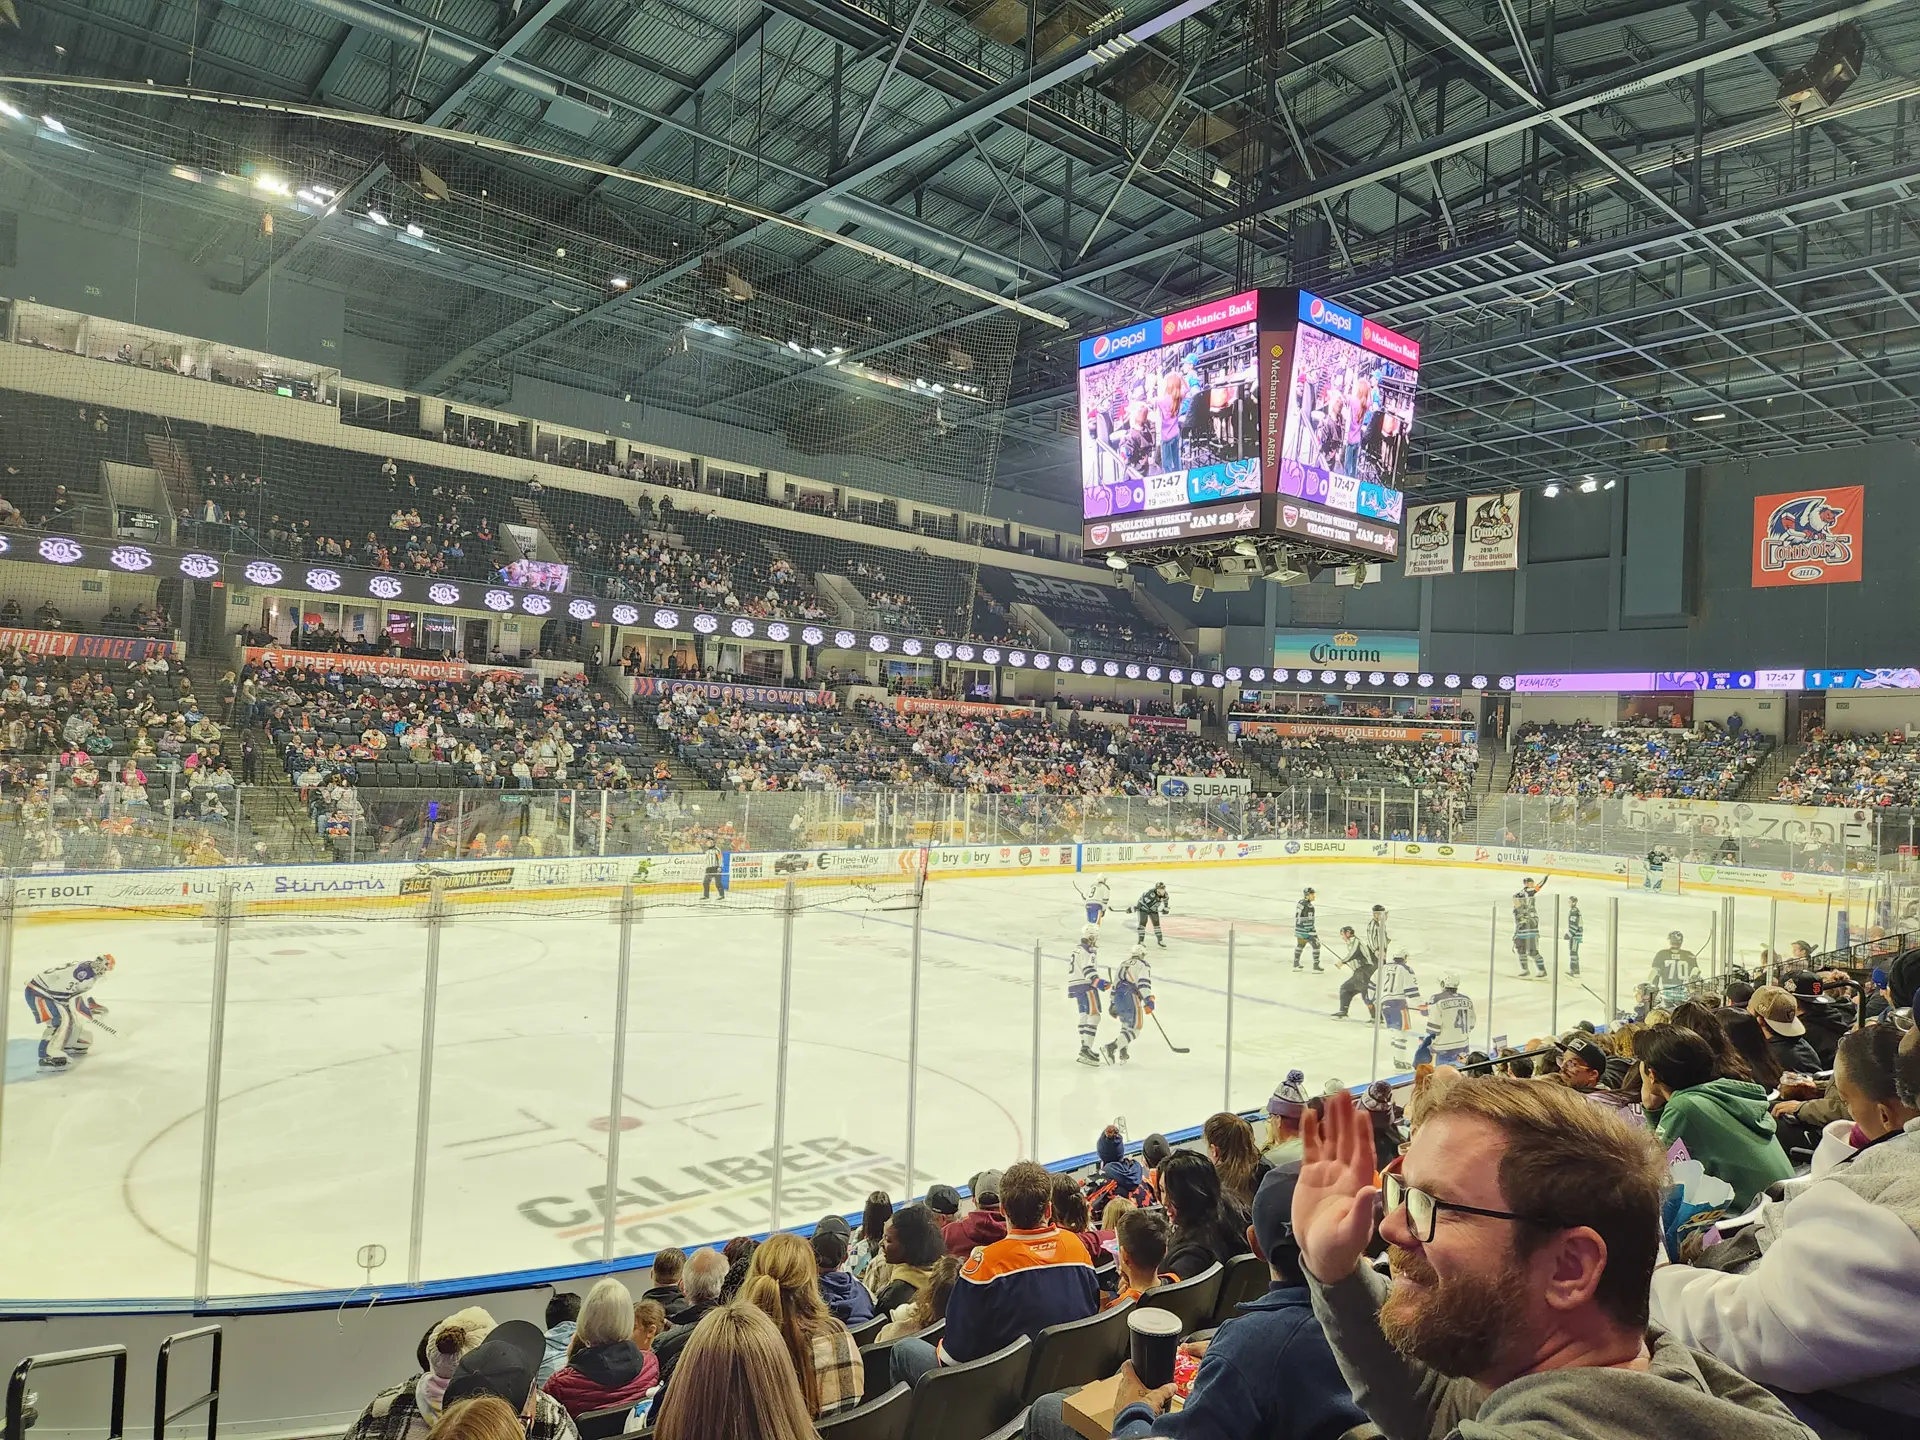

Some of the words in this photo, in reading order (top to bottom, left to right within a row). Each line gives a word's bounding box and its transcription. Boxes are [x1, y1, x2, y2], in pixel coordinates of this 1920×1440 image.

[1177, 307, 1227, 332] Mechanics
[1228, 300, 1254, 317] Bank
[1324, 310, 1352, 332] pepsi
[1111, 328, 1146, 353] pepsi
[1371, 331, 1403, 354] Mechanics
[1403, 344, 1418, 360] Bank
[1269, 359, 1281, 410] Mechanics
[1268, 412, 1279, 435] Bank
[1266, 437, 1276, 468] ARENA
[1151, 475, 1181, 490] 17:47
[1192, 477, 1200, 494] 1
[1319, 480, 1328, 496] 0
[1334, 476, 1356, 493] 17:47
[1133, 488, 1143, 503] 0
[1148, 498, 1157, 506] 19
[1176, 494, 1185, 502] 13
[1361, 490, 1366, 507] 1
[1111, 516, 1155, 533] PENDLETON
[1156, 512, 1192, 526] WHISKEY
[1190, 513, 1218, 529] JAN
[1219, 512, 1235, 526] 18
[1300, 507, 1333, 525] PENDLETON
[1332, 514, 1358, 532] WHISKEY
[1121, 529, 1159, 543] VELOCITY
[1160, 526, 1181, 537] TOUR
[1307, 522, 1335, 538] VELOCITY
[1356, 527, 1375, 543] JAN
[1374, 534, 1384, 545] 18
[40, 540, 83, 560] 805
[111, 548, 153, 567] 805
[1489, 552, 1513, 560] Division
[1761, 534, 1852, 571] CONDORS
[180, 556, 218, 575] 805
[244, 564, 281, 581] 805
[1413, 565, 1444, 573] Champions
[1795, 569, 1817, 577] AHL
[307, 571, 341, 587] 805
[368, 578, 402, 595] 805
[428, 586, 460, 601] 805
[484, 592, 515, 608] 805
[521, 596, 552, 612] 805
[568, 602, 597, 617] 805
[611, 607, 639, 622] 805
[653, 612, 679, 625] 805
[693, 616, 717, 630] 805
[731, 621, 754, 633] 805
[767, 625, 790, 638] 805
[802, 629, 825, 642] 805
[834, 633, 856, 645] 805
[0, 630, 74, 657] HOCKEY
[79, 636, 137, 660] SINCE
[869, 636, 890, 648] 805
[902, 640, 923, 651] 805
[933, 645, 954, 657] 805
[1309, 642, 1381, 667] Corona
[379, 660, 467, 680] CHEVROLET
[1765, 673, 1796, 682] 17:47
[1518, 678, 1562, 688] PENALTIES
[1738, 674, 1752, 687] 0
[1812, 673, 1821, 686] 1
[1290, 726, 1407, 739] 3WAYCHEVROLET.COM
[1193, 784, 1247, 797] SUBARU
[1303, 842, 1346, 851] SUBARU
[674, 857, 686, 865] Get
[831, 855, 879, 866] Three-Way
[942, 851, 959, 866] bry
[973, 850, 991, 865] bry
[1497, 850, 1530, 865] OUTLAW
[274, 875, 386, 893] Stinson's
[402, 877, 431, 894] EAGLE
[477, 868, 513, 886] CASINO
[51, 885, 94, 898] BOLT
[107, 882, 177, 899] Michelob
[1664, 959, 1689, 980] 70
[1383, 972, 1396, 993] 21
[1453, 1008, 1468, 1035] 41
[518, 1136, 878, 1229] CALIBER
[571, 1160, 938, 1263] COLLISION
[1029, 1242, 1057, 1251] CCM
